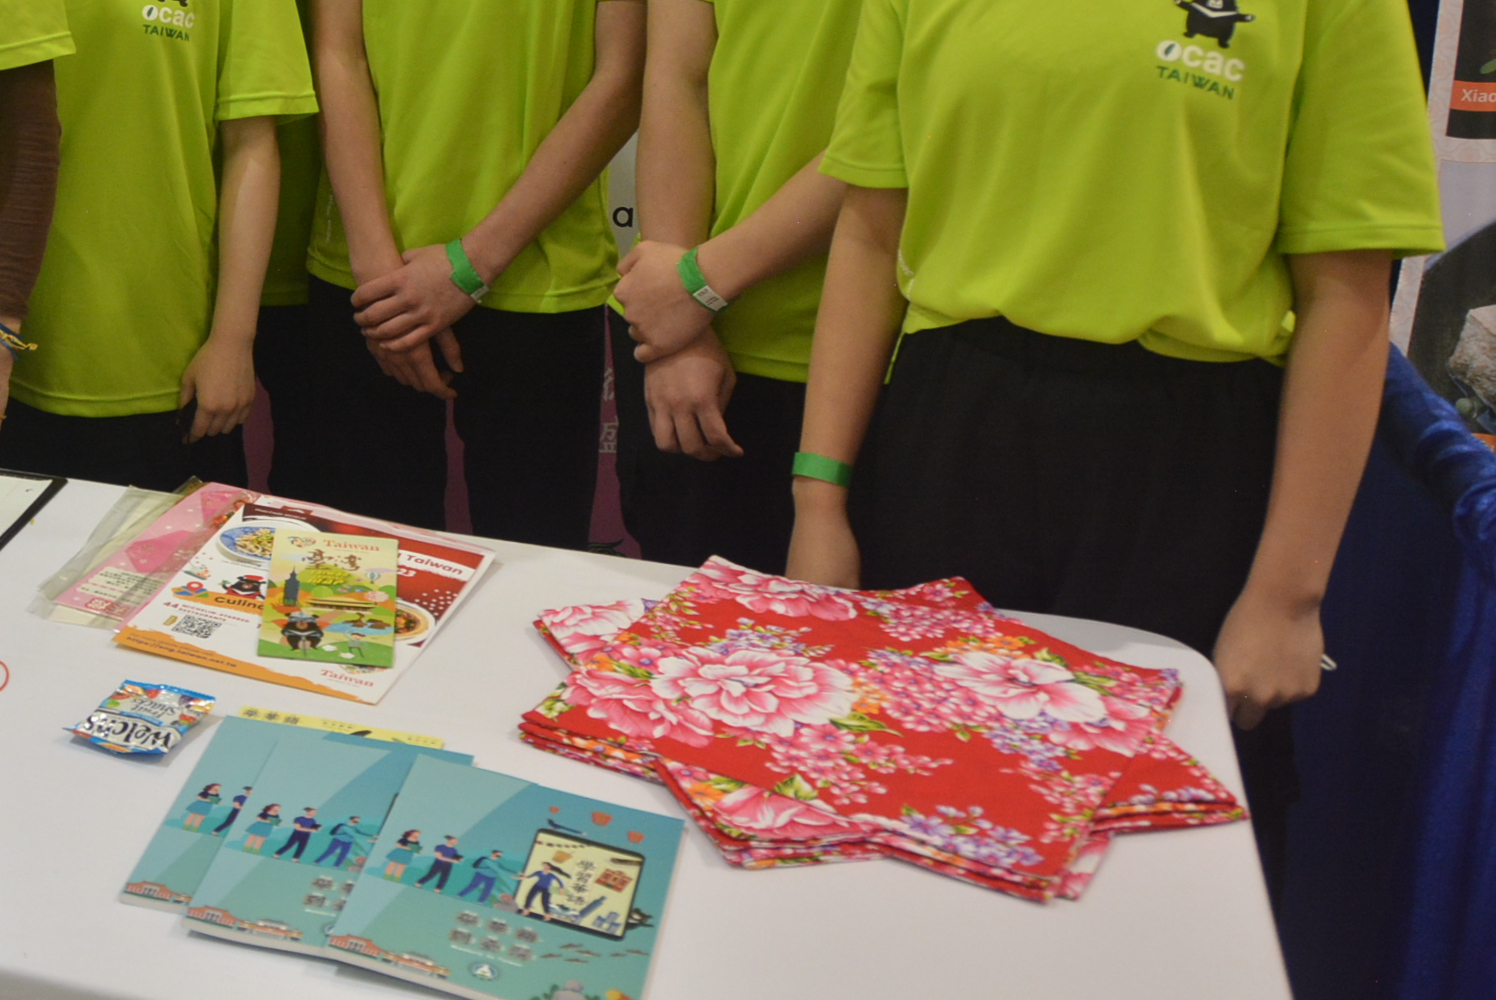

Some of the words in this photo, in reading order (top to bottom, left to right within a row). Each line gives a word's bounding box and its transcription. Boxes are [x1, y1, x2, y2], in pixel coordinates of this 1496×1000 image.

[141, 4, 196, 29] ocac
[142, 24, 191, 42] TAIWAN
[1155, 38, 1246, 82] ocac
[1156, 63, 1236, 102] TAIWAN
[322, 539, 380, 552] Taiwan
[406, 555, 463, 575] Taiwan
[320, 669, 375, 687] Taiwan
[130, 698, 180, 715] Snacks
